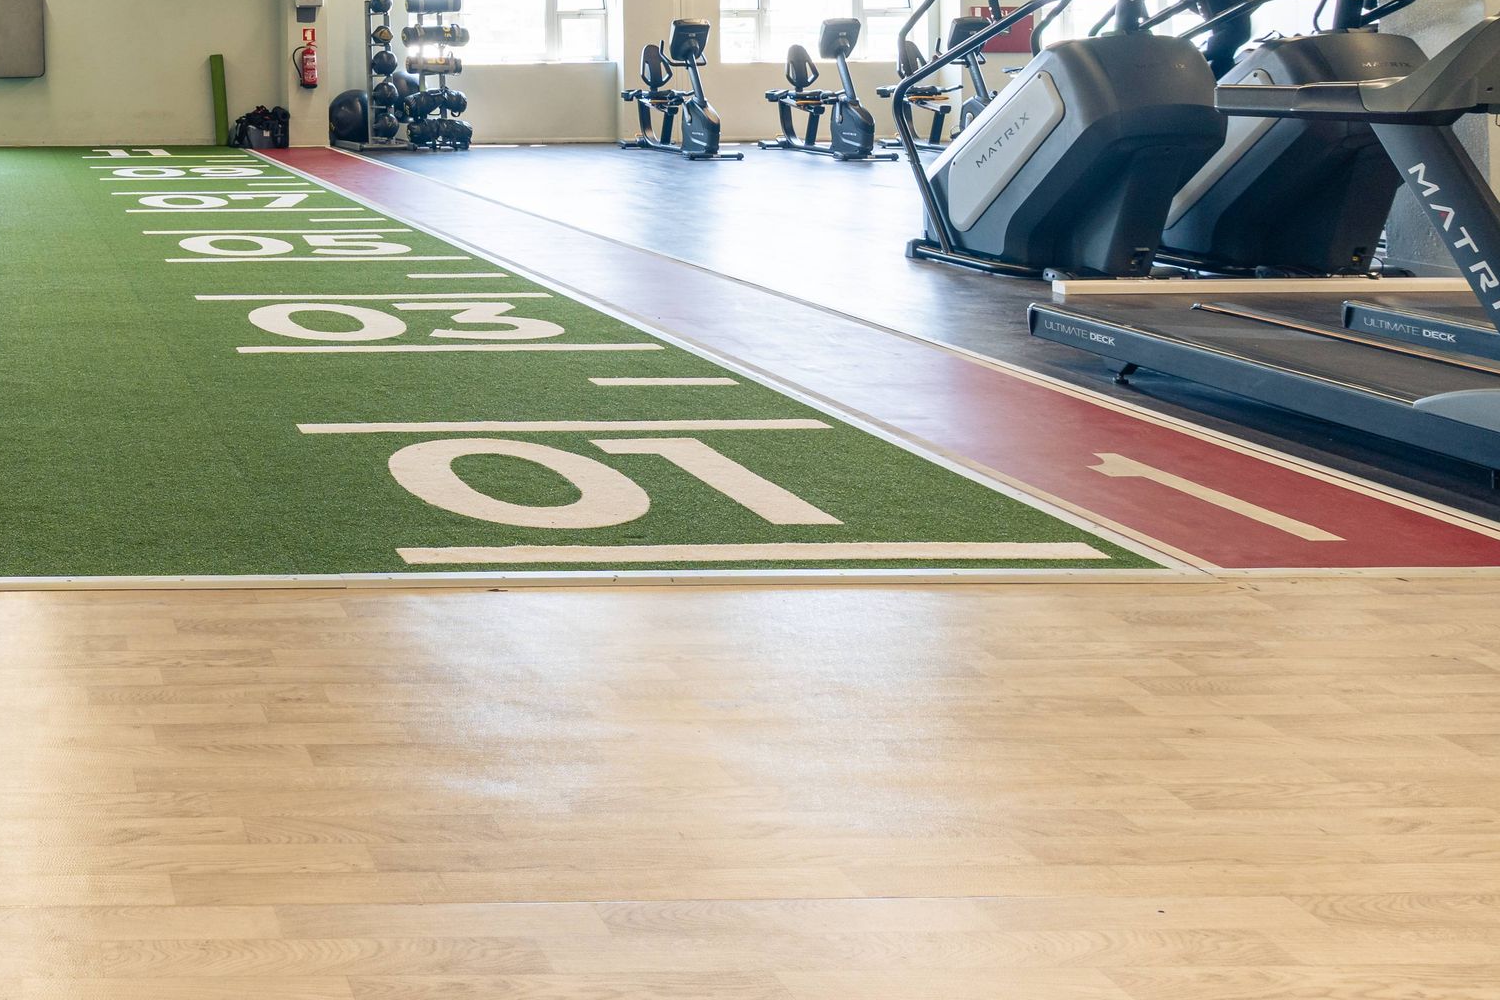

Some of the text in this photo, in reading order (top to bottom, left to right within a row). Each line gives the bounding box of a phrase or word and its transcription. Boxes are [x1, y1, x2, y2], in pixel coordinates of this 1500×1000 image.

[92, 149, 171, 157] 11
[975, 112, 1030, 168] MATRIX
[112, 167, 264, 177] 09
[138, 193, 309, 209] 07
[179, 234, 412, 256] 05
[248, 302, 565, 341] 03
[1044, 319, 1116, 346] ULTIMATE DECK
[1363, 317, 1456, 342] ULTIMATE DECK
[388, 438, 844, 529] 01
[1086, 452, 1346, 541] 1
